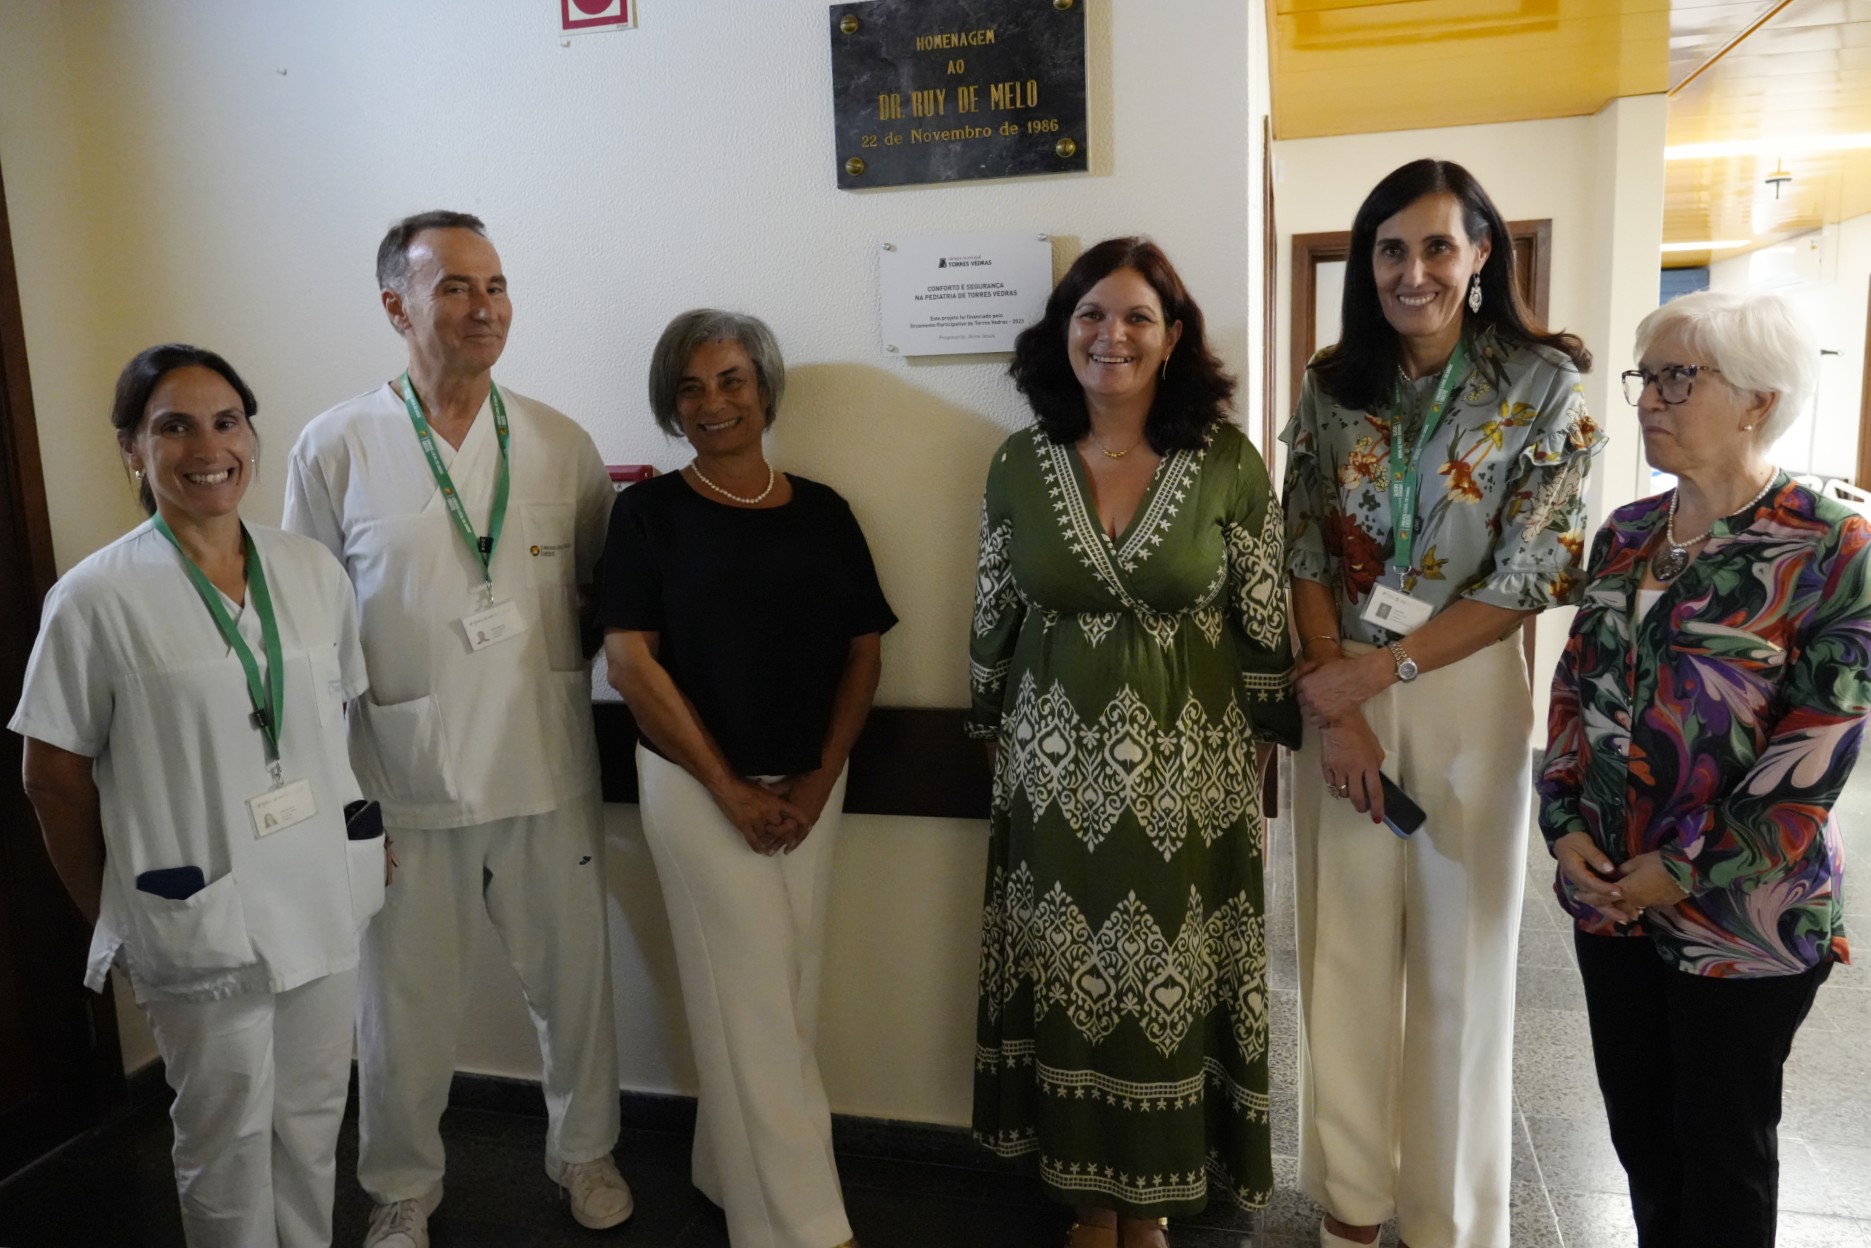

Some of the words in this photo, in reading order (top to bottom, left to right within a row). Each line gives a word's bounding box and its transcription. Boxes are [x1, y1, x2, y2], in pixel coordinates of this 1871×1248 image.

[916, 29, 995, 51] HOMENAGEM
[947, 60, 965, 75] AO
[912, 89, 946, 118] RUY
[957, 85, 979, 113] DE
[990, 79, 1038, 110] MELO
[861, 135, 877, 147] 22
[885, 131, 903, 145] de
[911, 125, 992, 144] Novembro
[1000, 121, 1019, 136] de
[1027, 119, 1059, 133] 1986
[993, 289, 1018, 297] VEDRAS
